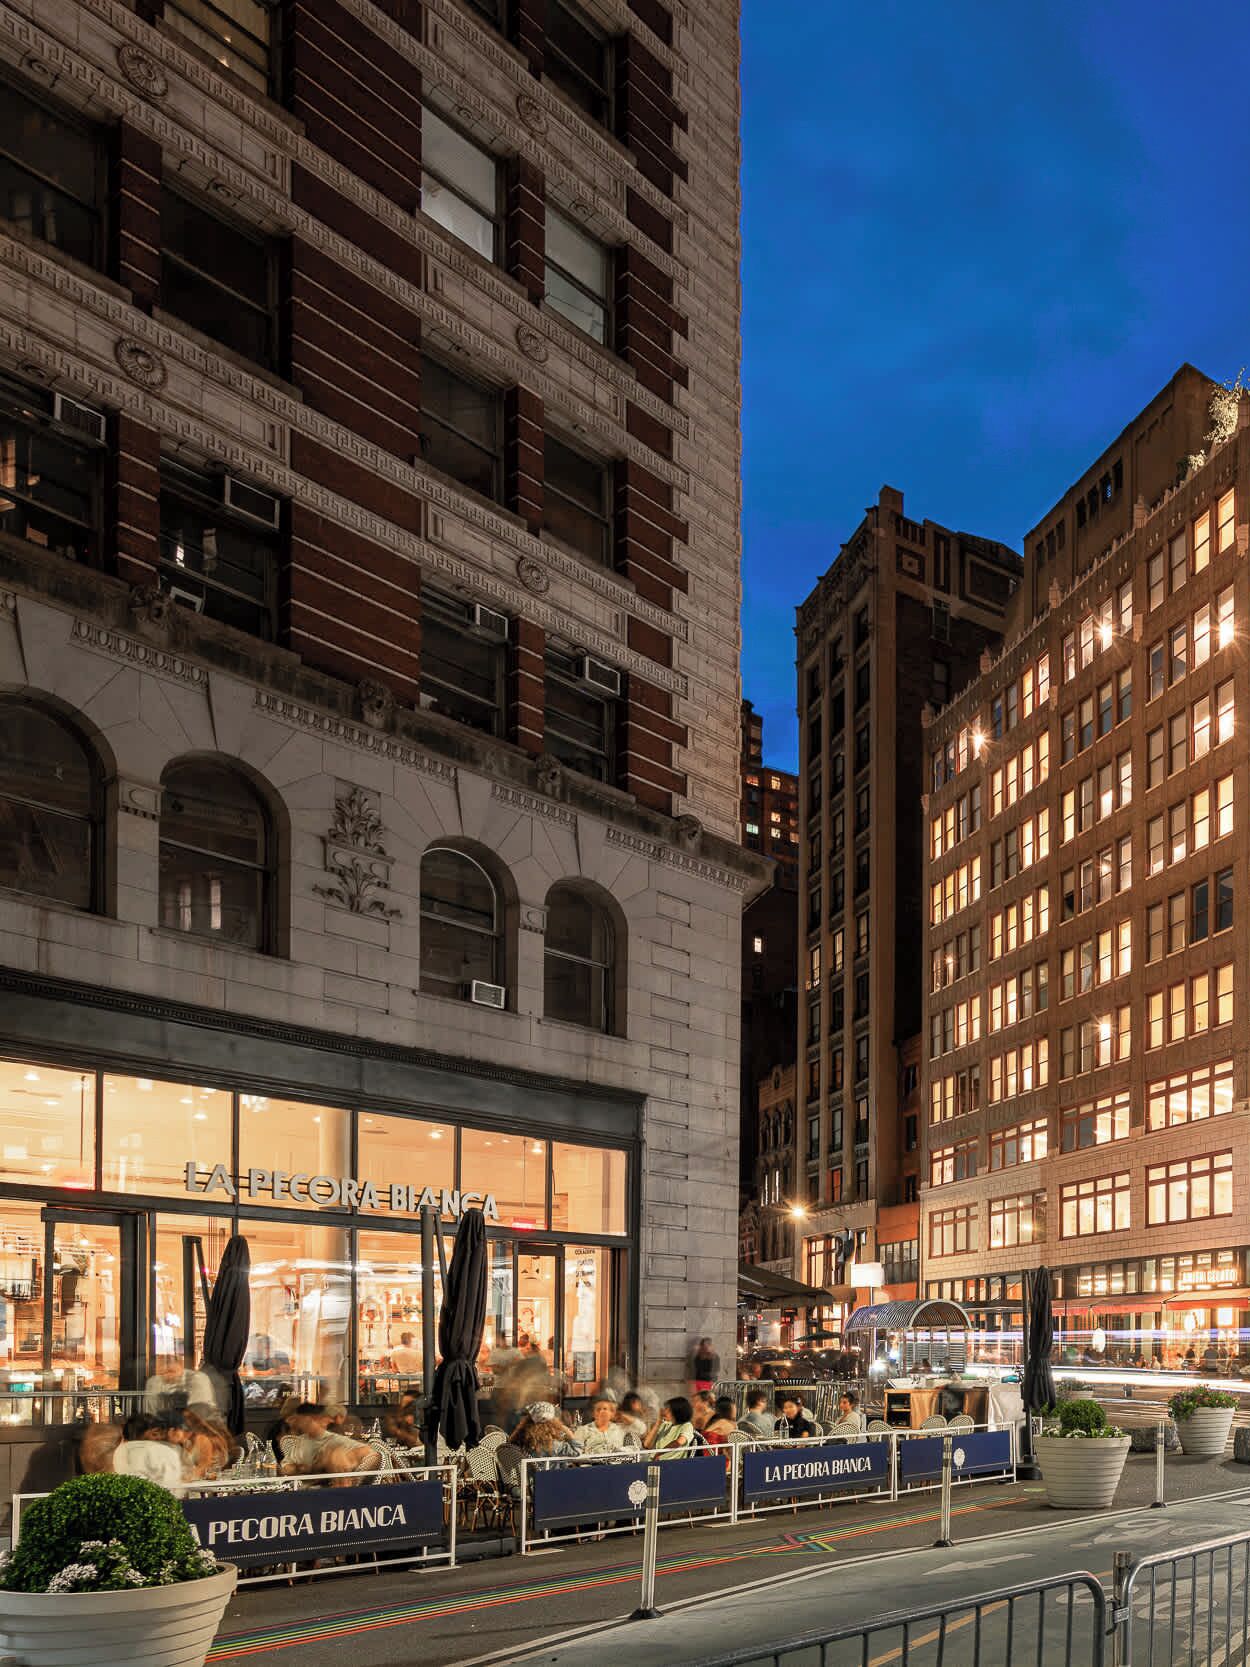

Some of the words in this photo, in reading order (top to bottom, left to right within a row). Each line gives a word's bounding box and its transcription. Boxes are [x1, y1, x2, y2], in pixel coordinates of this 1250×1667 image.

[185, 1161, 237, 1196] LA
[248, 1168, 381, 1210] PECORA
[390, 1182, 499, 1220] BIANCA
[765, 1466, 781, 1483] LA
[783, 1461, 830, 1481] PECORA
[831, 1456, 872, 1475] BIANCA
[190, 1523, 201, 1547] A
[208, 1513, 314, 1545] PECORA
[320, 1504, 407, 1533] BIANCA
